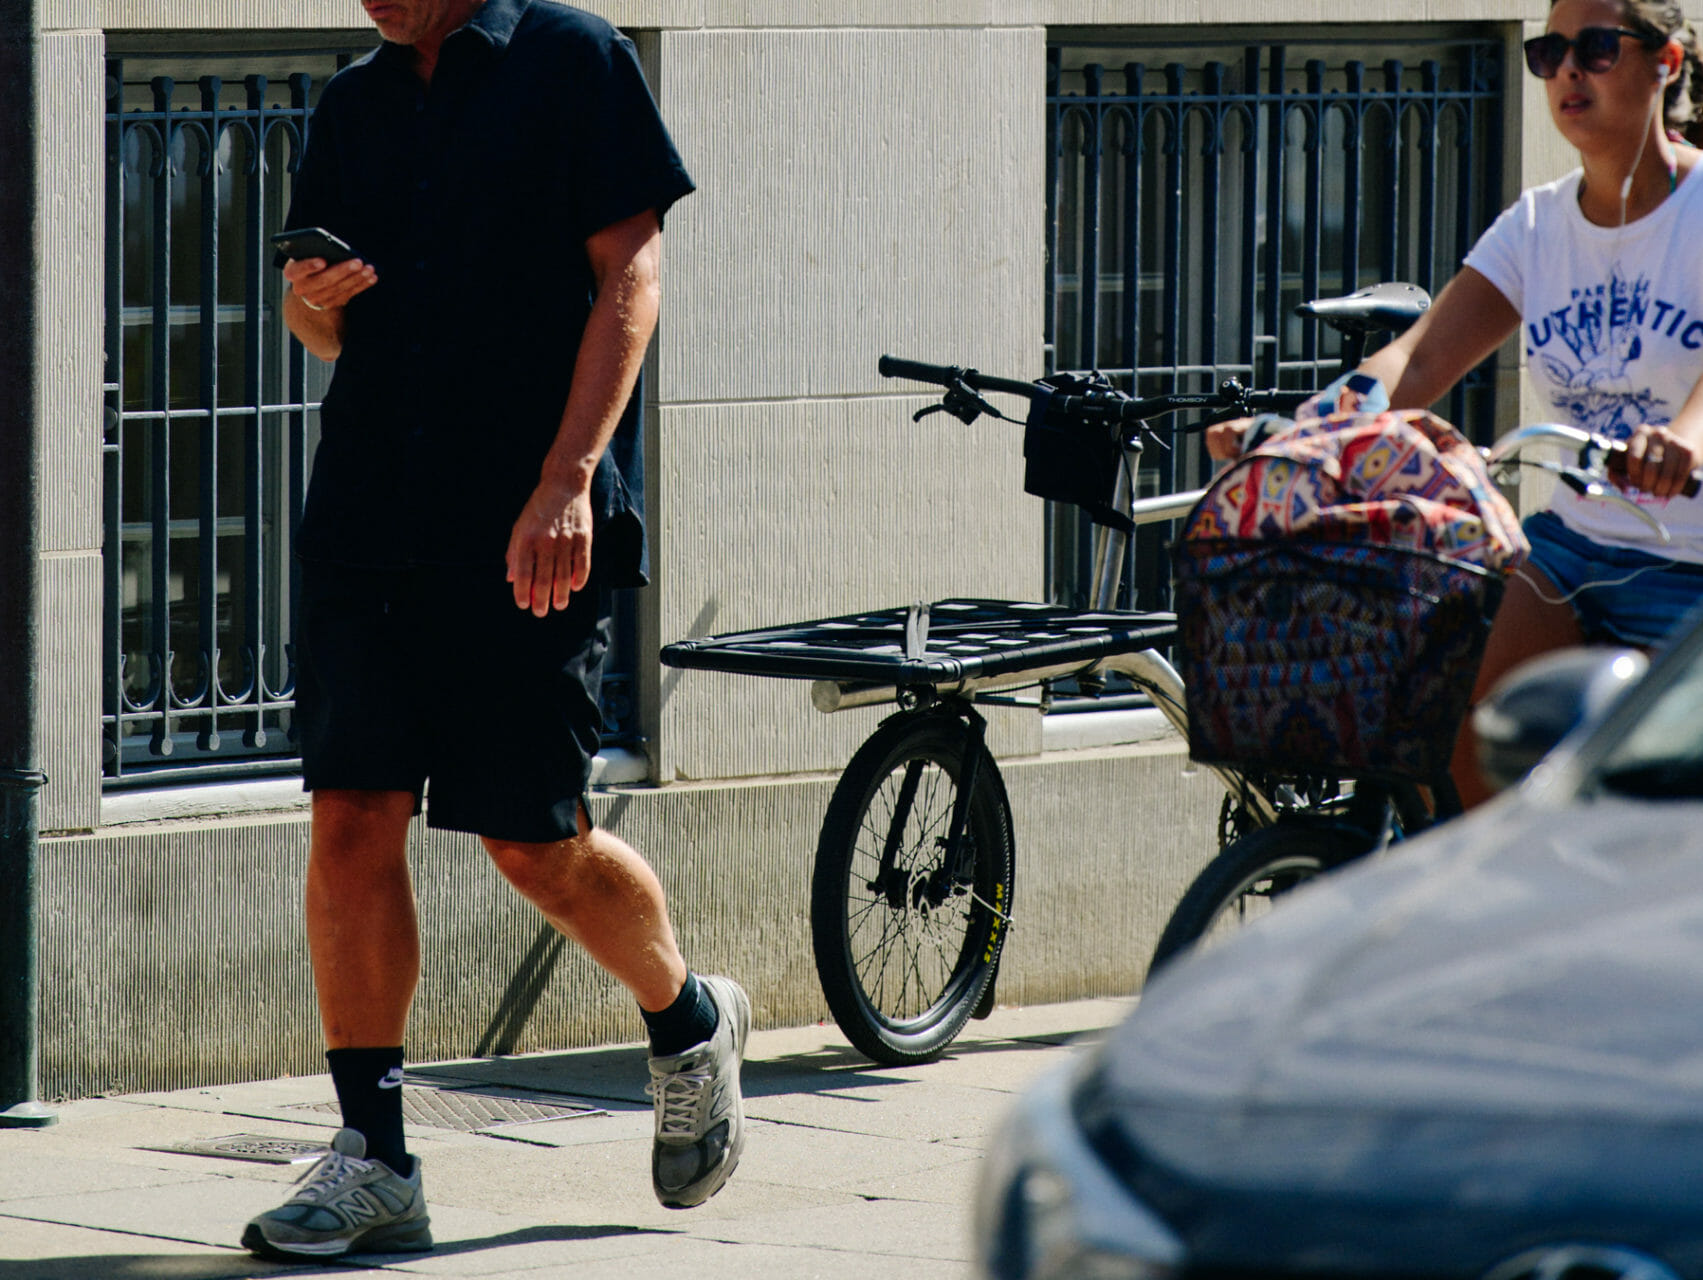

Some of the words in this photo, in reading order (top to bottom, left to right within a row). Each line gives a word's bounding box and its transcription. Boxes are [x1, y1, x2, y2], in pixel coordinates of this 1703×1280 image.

[1527, 298, 1703, 357] UTHENTIC
[983, 882, 1004, 964] MAXXIS
[335, 1191, 377, 1228] N
